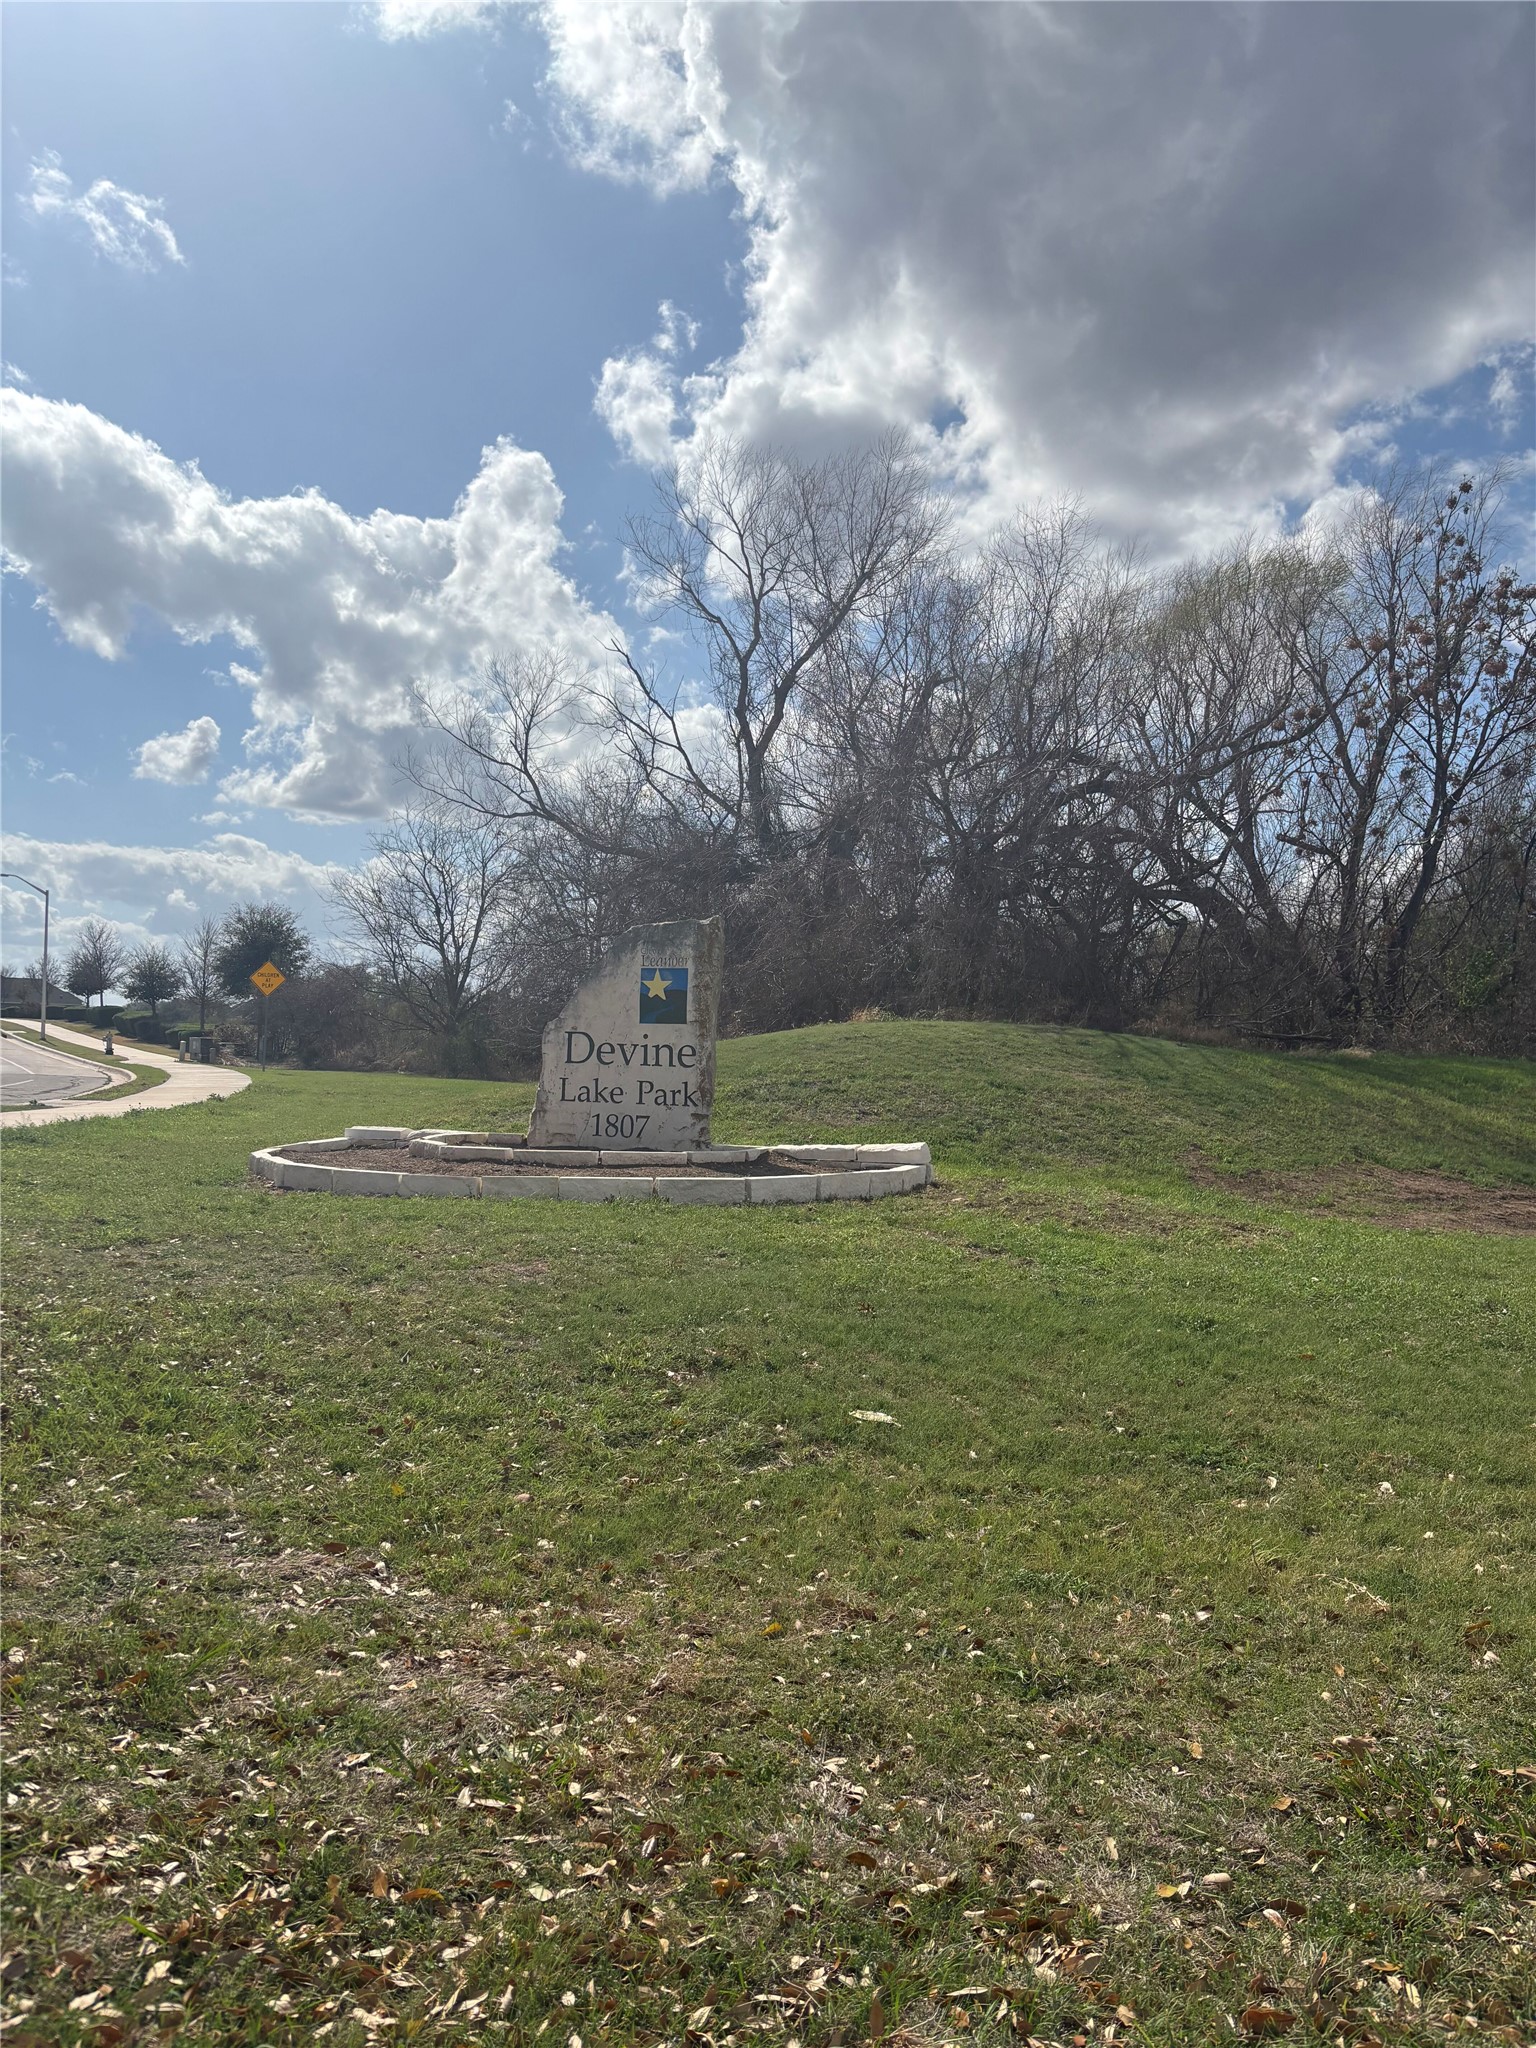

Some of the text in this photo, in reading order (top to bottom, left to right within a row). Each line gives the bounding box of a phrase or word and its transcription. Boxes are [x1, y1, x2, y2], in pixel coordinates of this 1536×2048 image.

[565, 1031, 696, 1068] Devine
[559, 1077, 700, 1108] Lake Park
[592, 1113, 651, 1139] 1807
